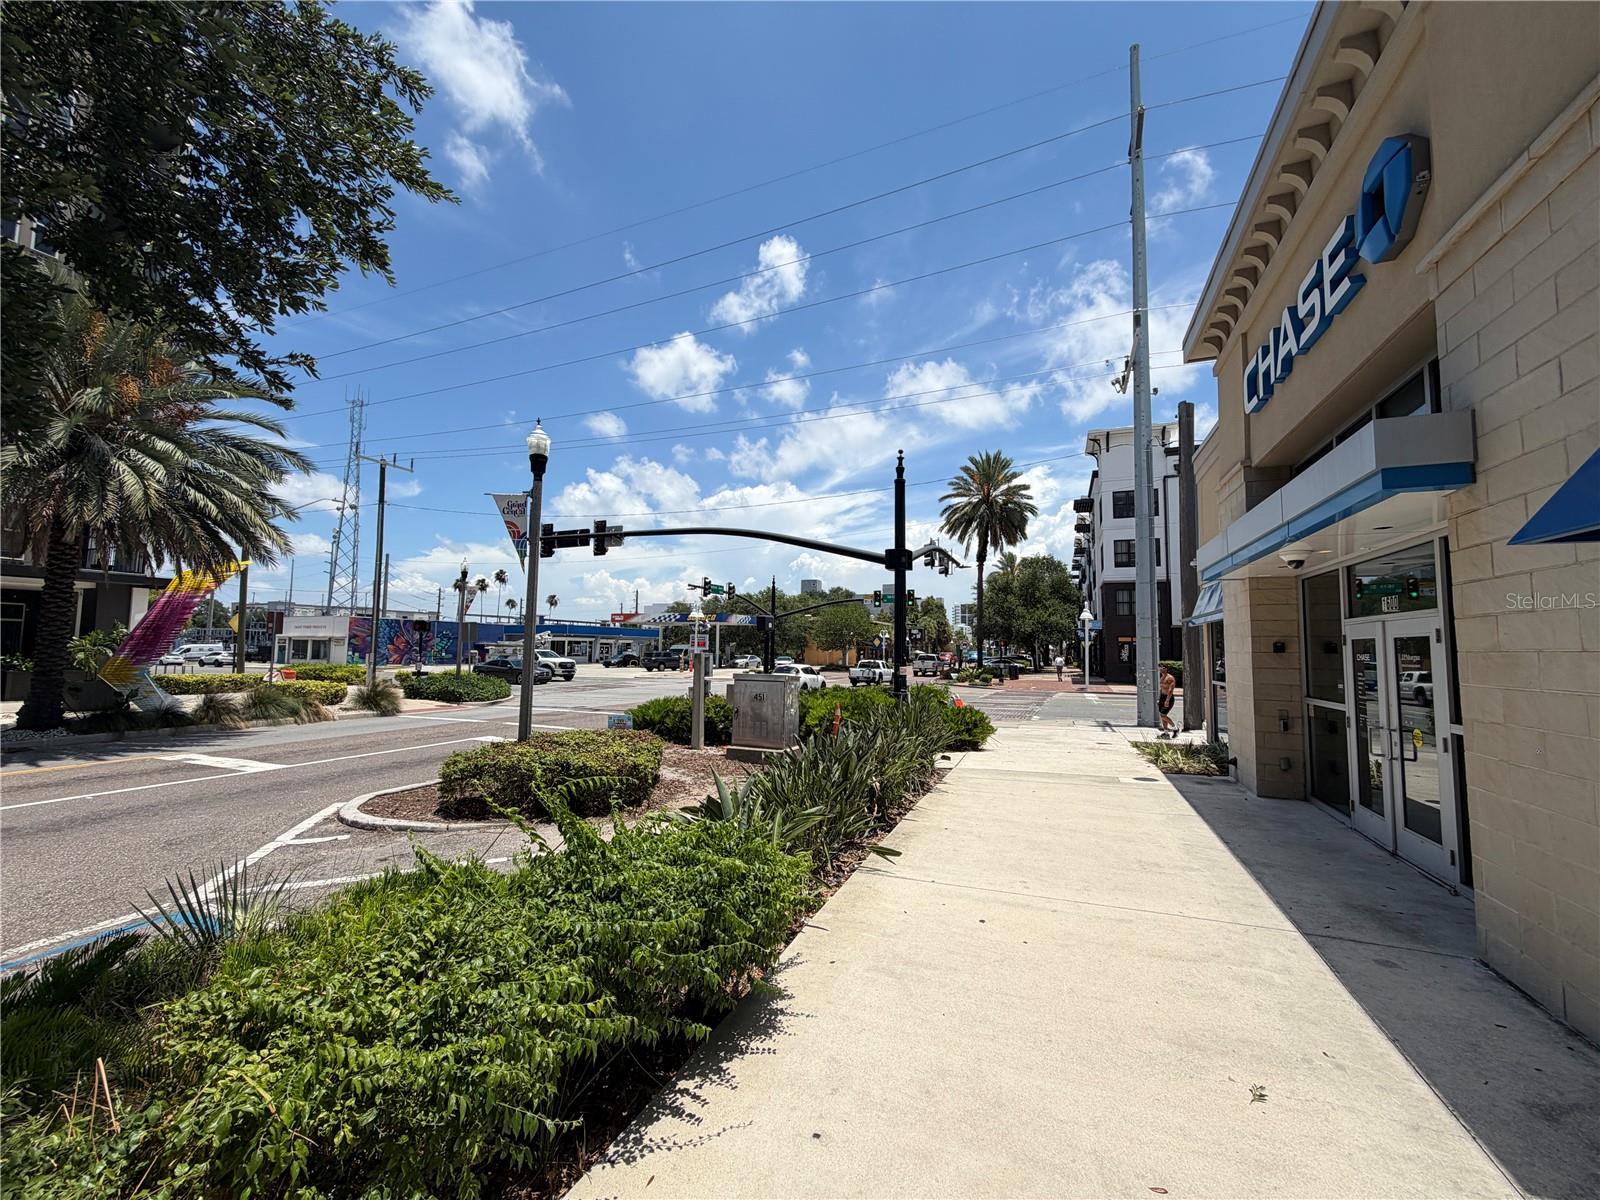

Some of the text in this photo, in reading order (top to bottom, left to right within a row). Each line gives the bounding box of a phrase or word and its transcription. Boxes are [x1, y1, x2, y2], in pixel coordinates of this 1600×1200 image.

[1242, 214, 1362, 414] CHASE
[507, 500, 527, 509] Grand
[502, 507, 526, 517] Central
[1356, 653, 1371, 661] CHASE
[753, 693, 765, 701] 451
